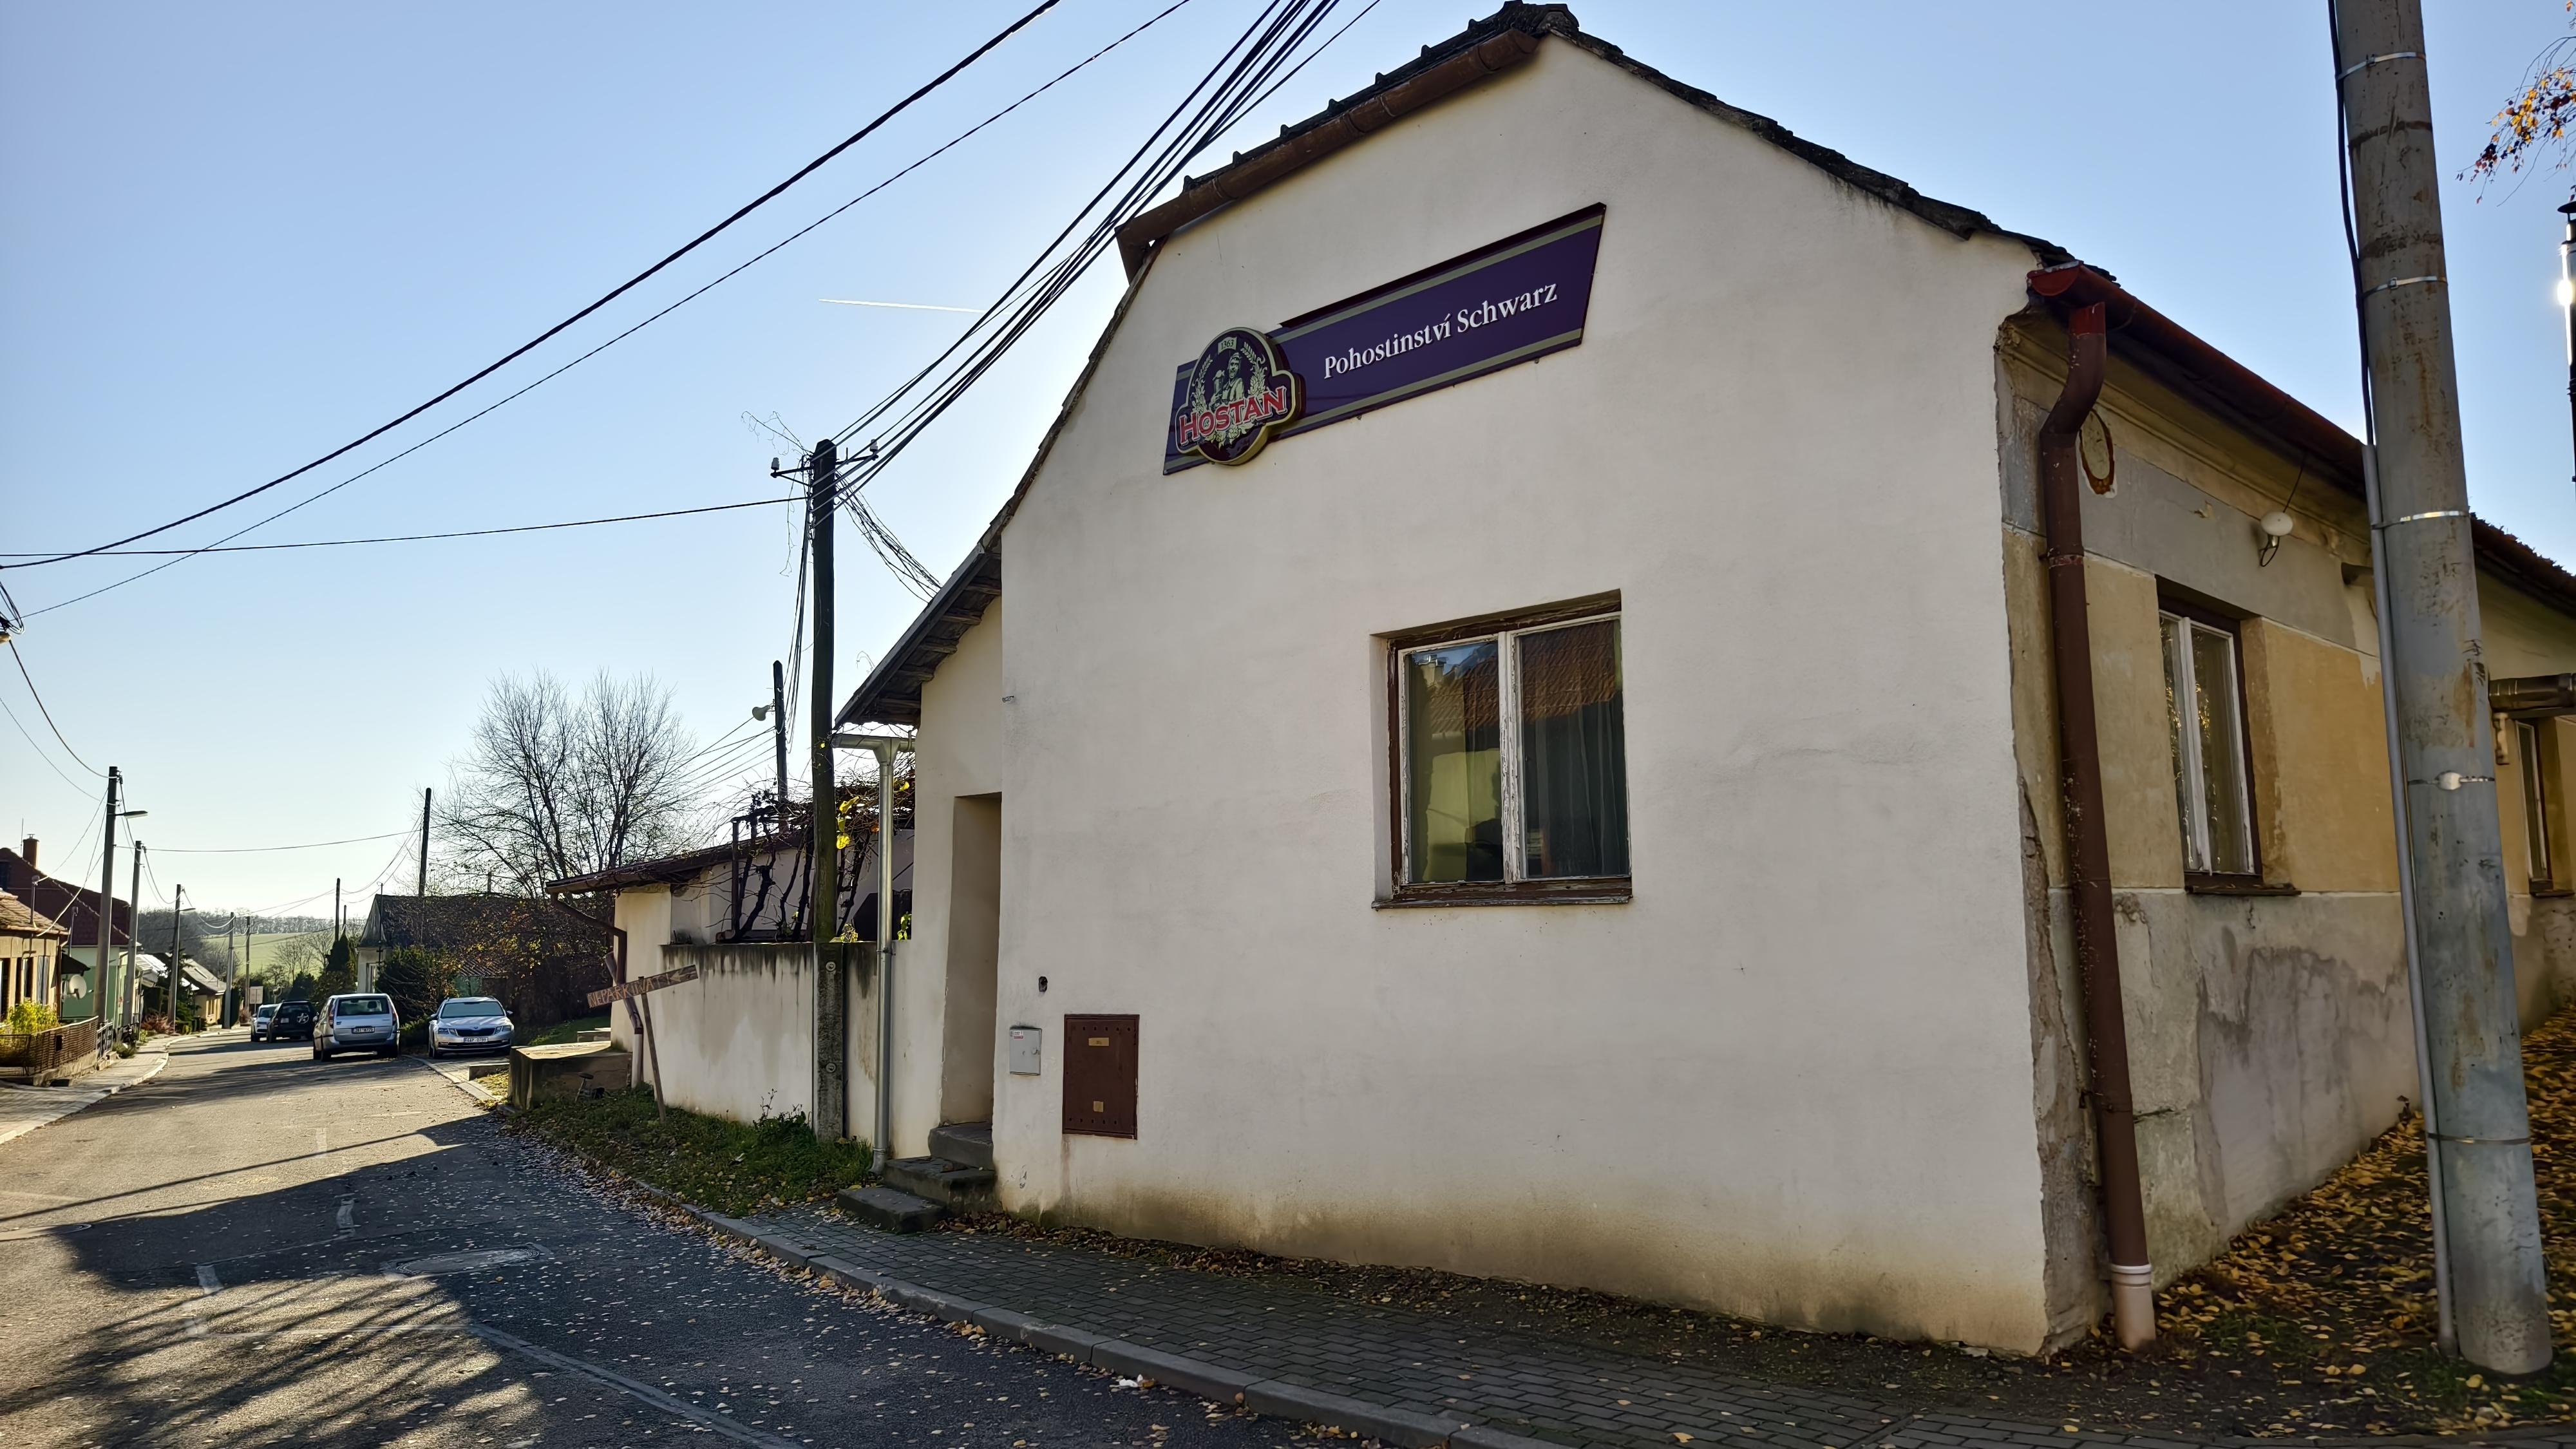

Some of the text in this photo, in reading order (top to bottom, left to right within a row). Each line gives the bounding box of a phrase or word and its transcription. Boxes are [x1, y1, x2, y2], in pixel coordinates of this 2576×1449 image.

[1221, 339, 1233, 350] 1363
[1324, 283, 1558, 379] Pohostinství Schwarz
[1179, 386, 1287, 446] HOSTAN
